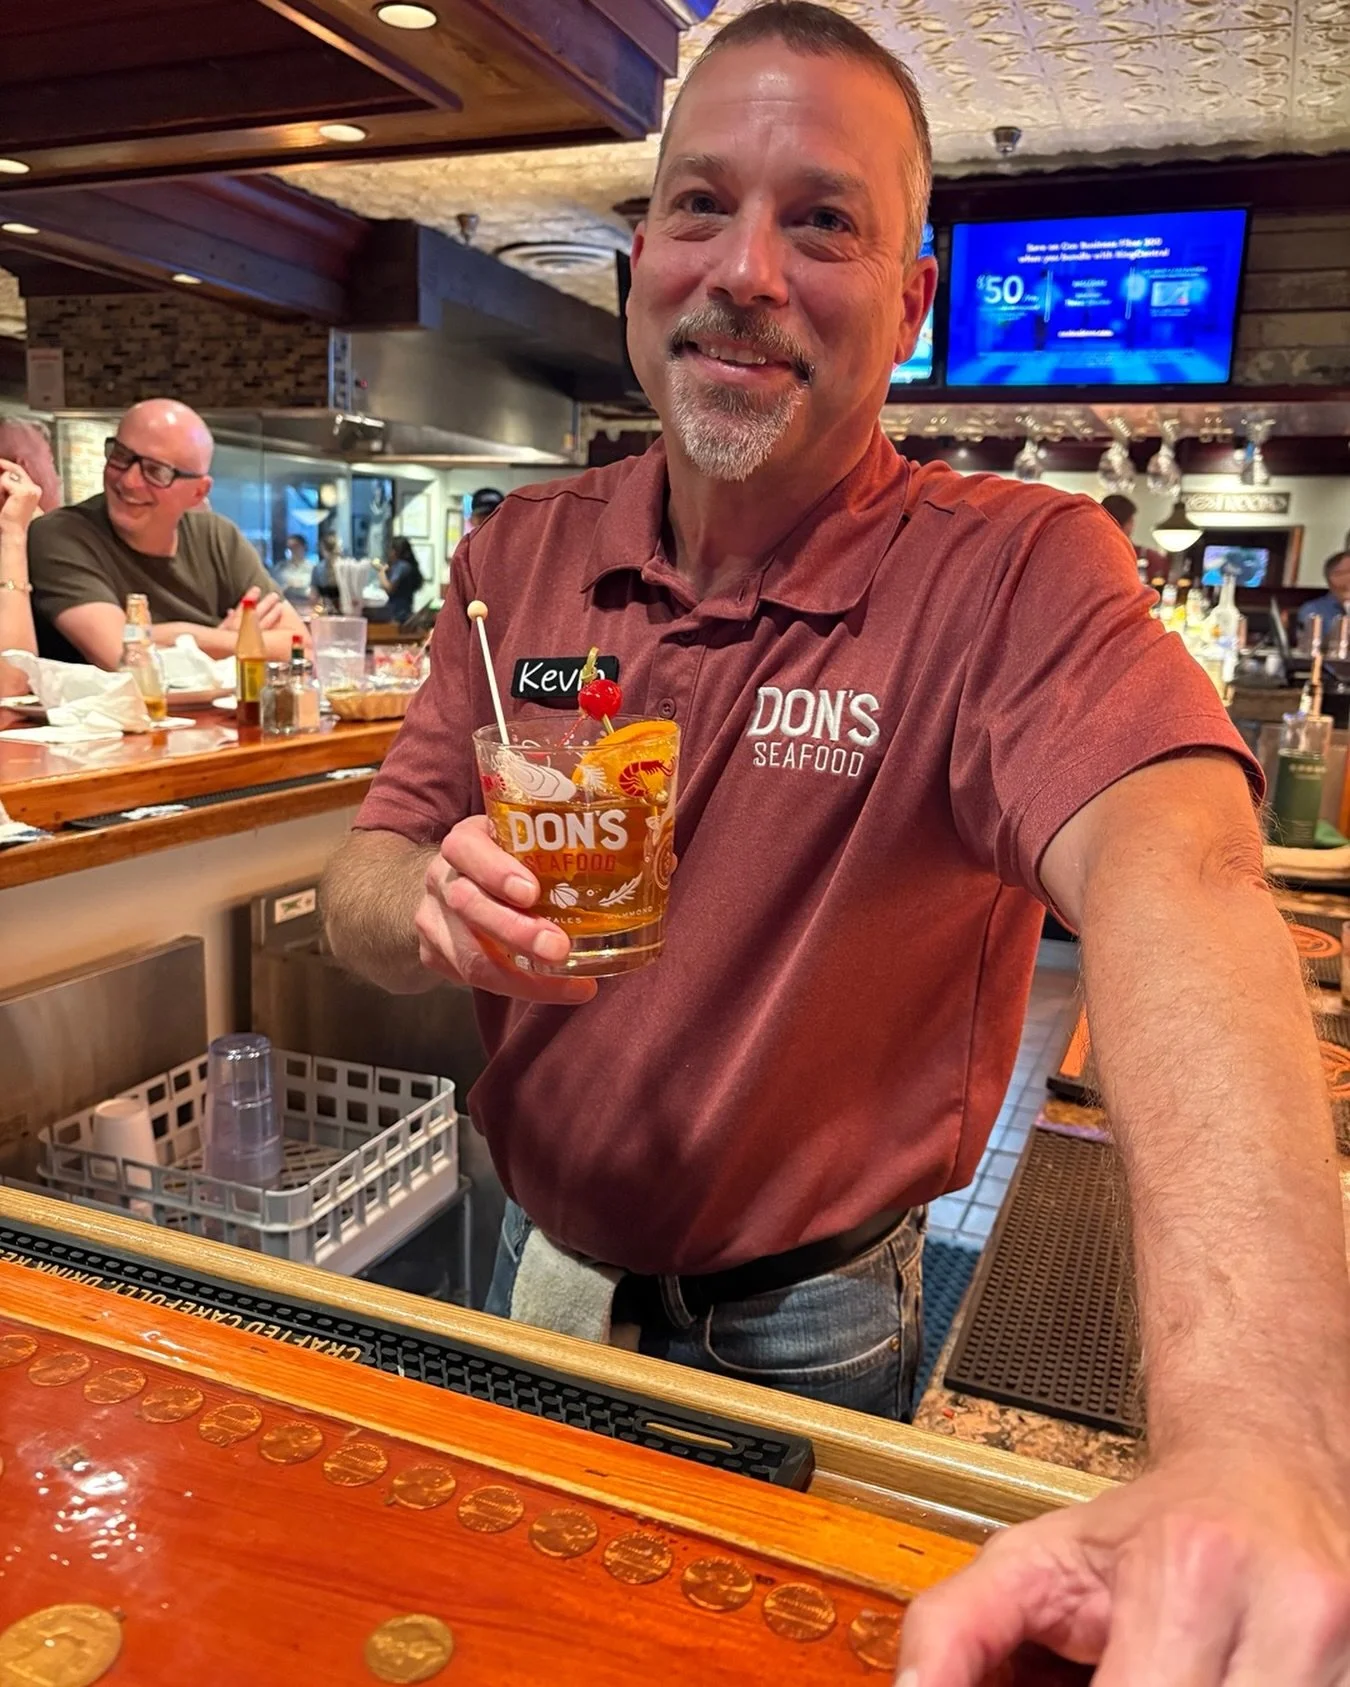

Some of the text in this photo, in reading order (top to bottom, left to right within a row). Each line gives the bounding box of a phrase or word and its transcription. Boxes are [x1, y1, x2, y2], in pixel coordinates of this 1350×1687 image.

[746, 687, 881, 747] DON'S
[752, 742, 864, 777] SEAFOOD
[507, 809, 629, 852] DON'S
[523, 853, 617, 873] SEAFOOD
[35, 1260, 104, 1288] DRINK
[243, 1321, 361, 1362] CRAFTED
